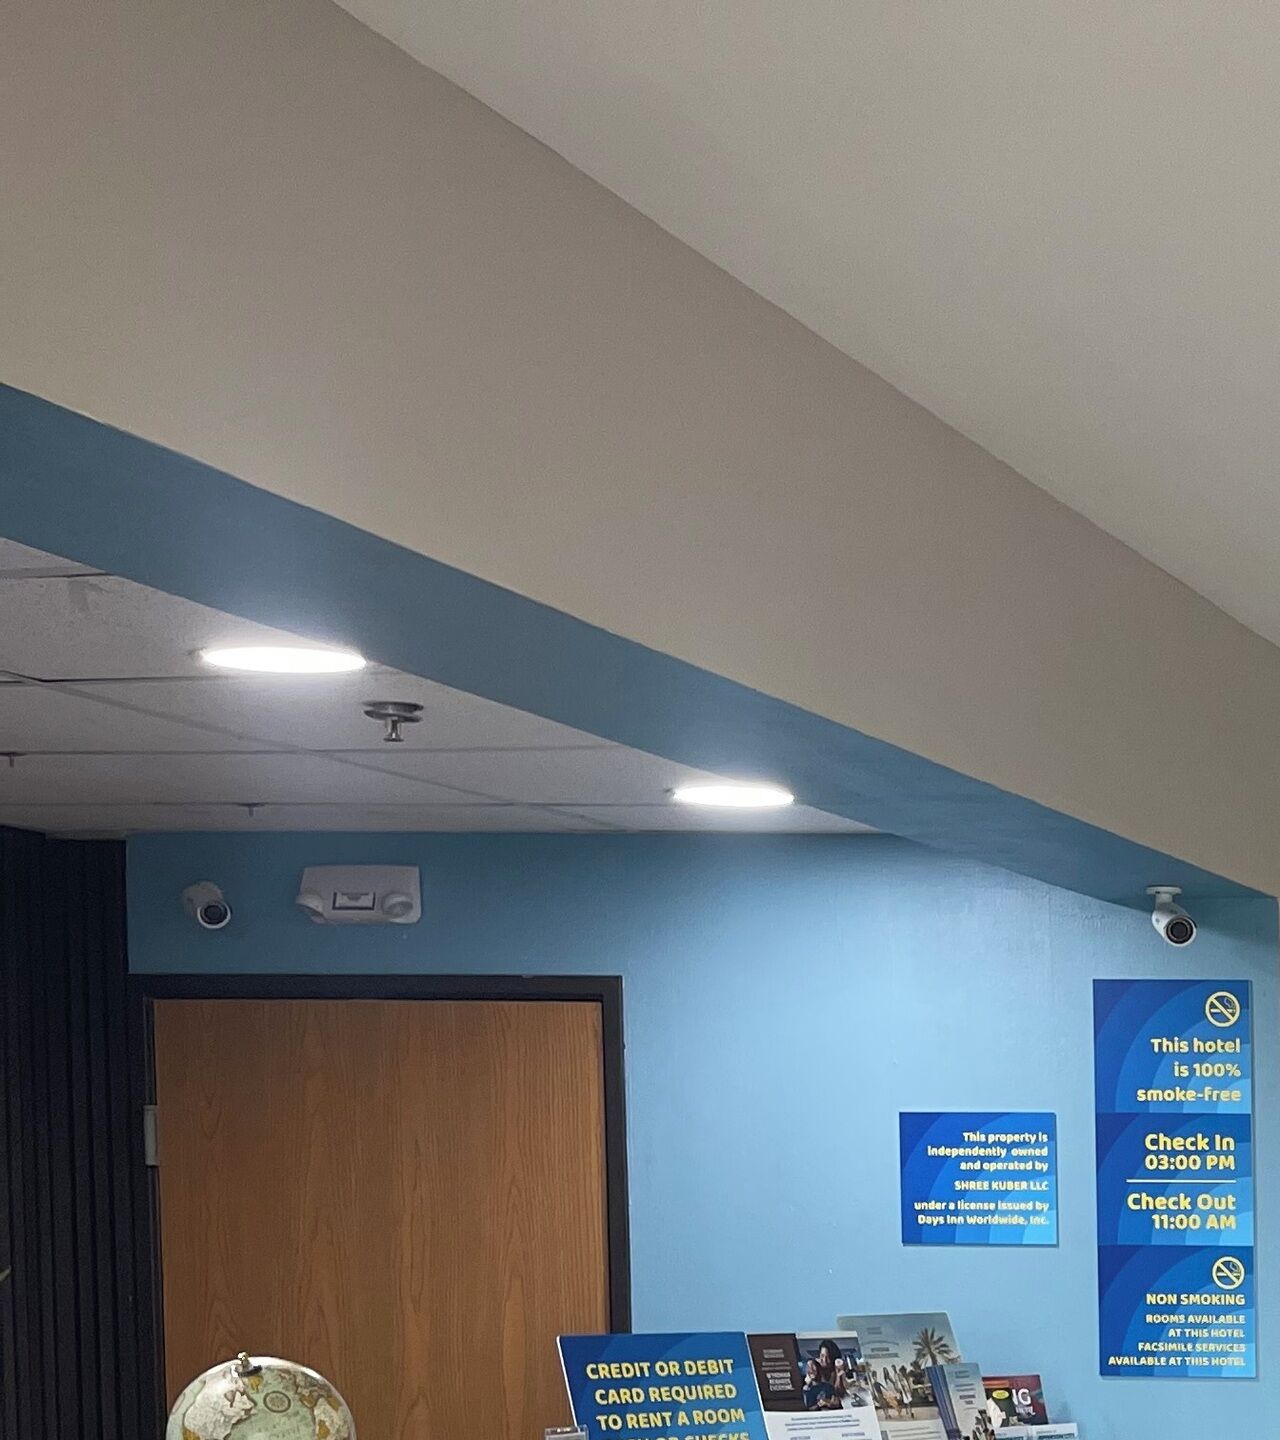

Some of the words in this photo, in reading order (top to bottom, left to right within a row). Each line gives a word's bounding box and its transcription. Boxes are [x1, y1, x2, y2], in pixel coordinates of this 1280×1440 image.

[1150, 1036, 1189, 1053] This
[1193, 1037, 1240, 1053] hotel
[1173, 1061, 1189, 1077] is
[1193, 1063, 1242, 1077] 100%
[1136, 1086, 1242, 1102] smoke-free
[962, 1131, 986, 1142] This
[988, 1132, 1037, 1144] property
[1038, 1131, 1049, 1142] is
[1144, 1132, 1210, 1151] Check
[1214, 1134, 1236, 1151] In
[1010, 1147, 1049, 1157] owned
[959, 1160, 981, 1170] and
[982, 1161, 1033, 1172] operated
[1034, 1161, 1049, 1172] by
[1144, 1154, 1201, 1170] 03:00
[1206, 1155, 1236, 1170] PM
[954, 1180, 990, 1191] SHREE
[991, 1180, 1028, 1191] KUBER
[1030, 1181, 1050, 1191] LLC
[914, 1200, 946, 1211] under
[948, 1203, 956, 1211] a
[957, 1199, 996, 1211] license
[997, 1200, 1034, 1211] issued
[1035, 1201, 1050, 1213] by
[1126, 1192, 1192, 1210] Check
[1196, 1193, 1237, 1210] Out
[917, 1214, 945, 1226] Days
[946, 1214, 965, 1225] Inn
[966, 1214, 1028, 1226] Worldwide,
[1029, 1215, 1050, 1225] Inc.
[1151, 1213, 1201, 1230] 11:00
[1206, 1214, 1237, 1230] AM
[1146, 1293, 1177, 1305] NON
[1180, 1293, 1246, 1306] SMOKING
[1145, 1314, 1185, 1324] ROOMS
[1187, 1314, 1246, 1324] AVAILABLE
[1168, 1328, 1183, 1338] AT
[1185, 1328, 1209, 1338] THIS
[1211, 1328, 1245, 1338] HOTEL
[1137, 1342, 1193, 1353] FACSIMILE
[1195, 1343, 1246, 1353] SERVICES
[1108, 1355, 1167, 1366] AVAILABLE
[1168, 1356, 1184, 1366] AT
[1185, 1356, 1209, 1366] THIS
[1211, 1356, 1246, 1366] HOTEL
[586, 1361, 650, 1380] CREDIT
[654, 1361, 681, 1377] OR
[684, 1359, 734, 1376] DEBIT
[595, 1387, 645, 1405] CARD
[648, 1384, 737, 1404] REQUIRED
[596, 1414, 623, 1431] TO
[626, 1411, 672, 1429] RENT
[677, 1411, 690, 1426] A
[692, 1408, 746, 1425] ROOM
